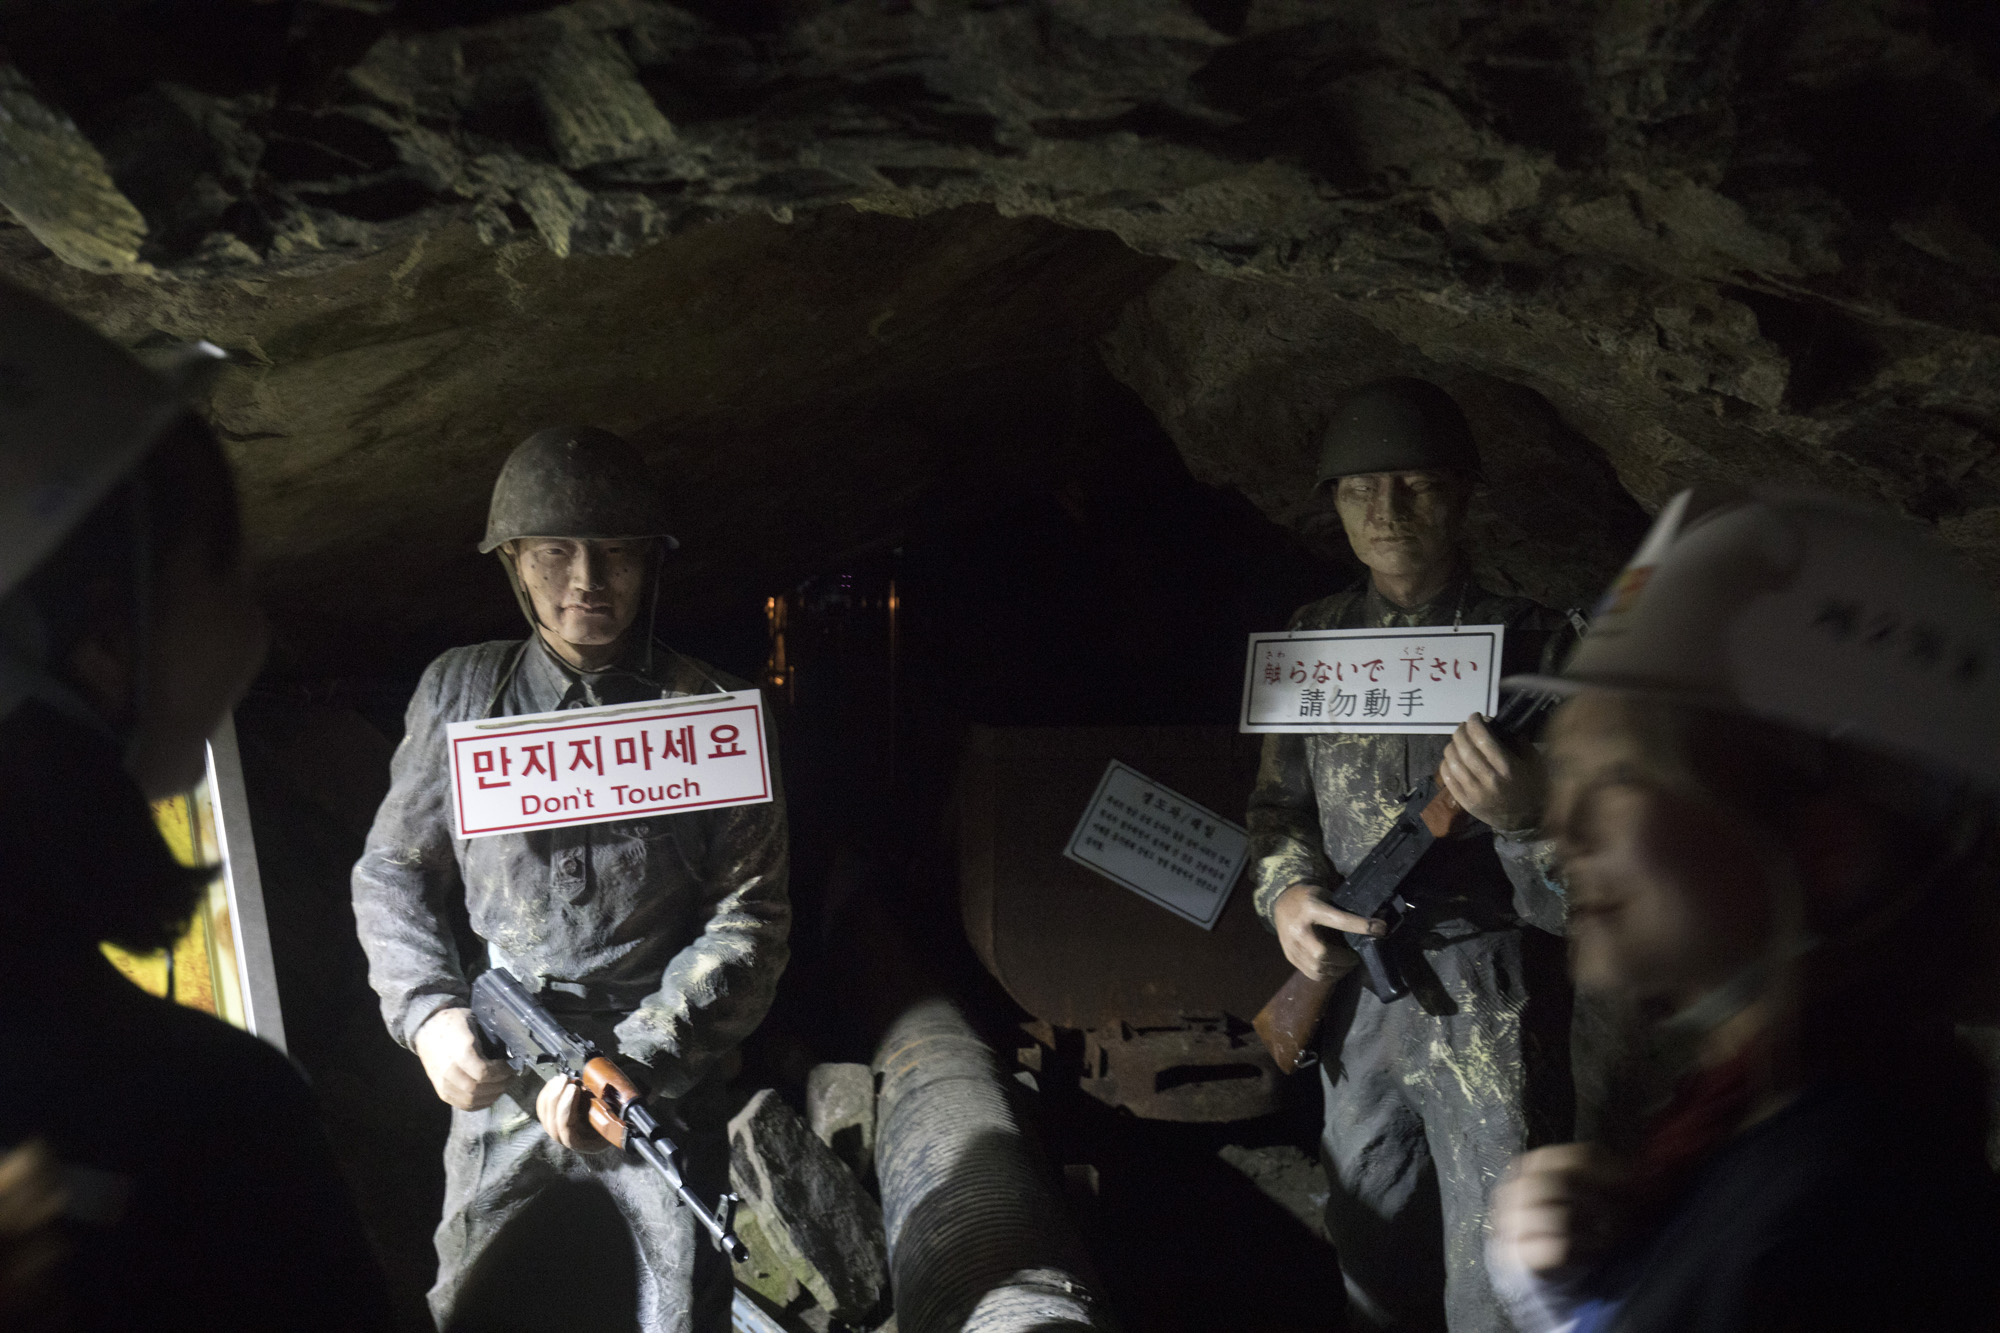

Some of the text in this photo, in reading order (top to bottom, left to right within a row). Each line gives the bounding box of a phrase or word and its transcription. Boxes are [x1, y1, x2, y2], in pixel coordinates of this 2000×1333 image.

[1400, 657, 1479, 683] 下さい
[1299, 687, 1425, 718] 請勿動手
[472, 724, 748, 790] 만지지마세요
[520, 777, 701, 816] Don't Touch
